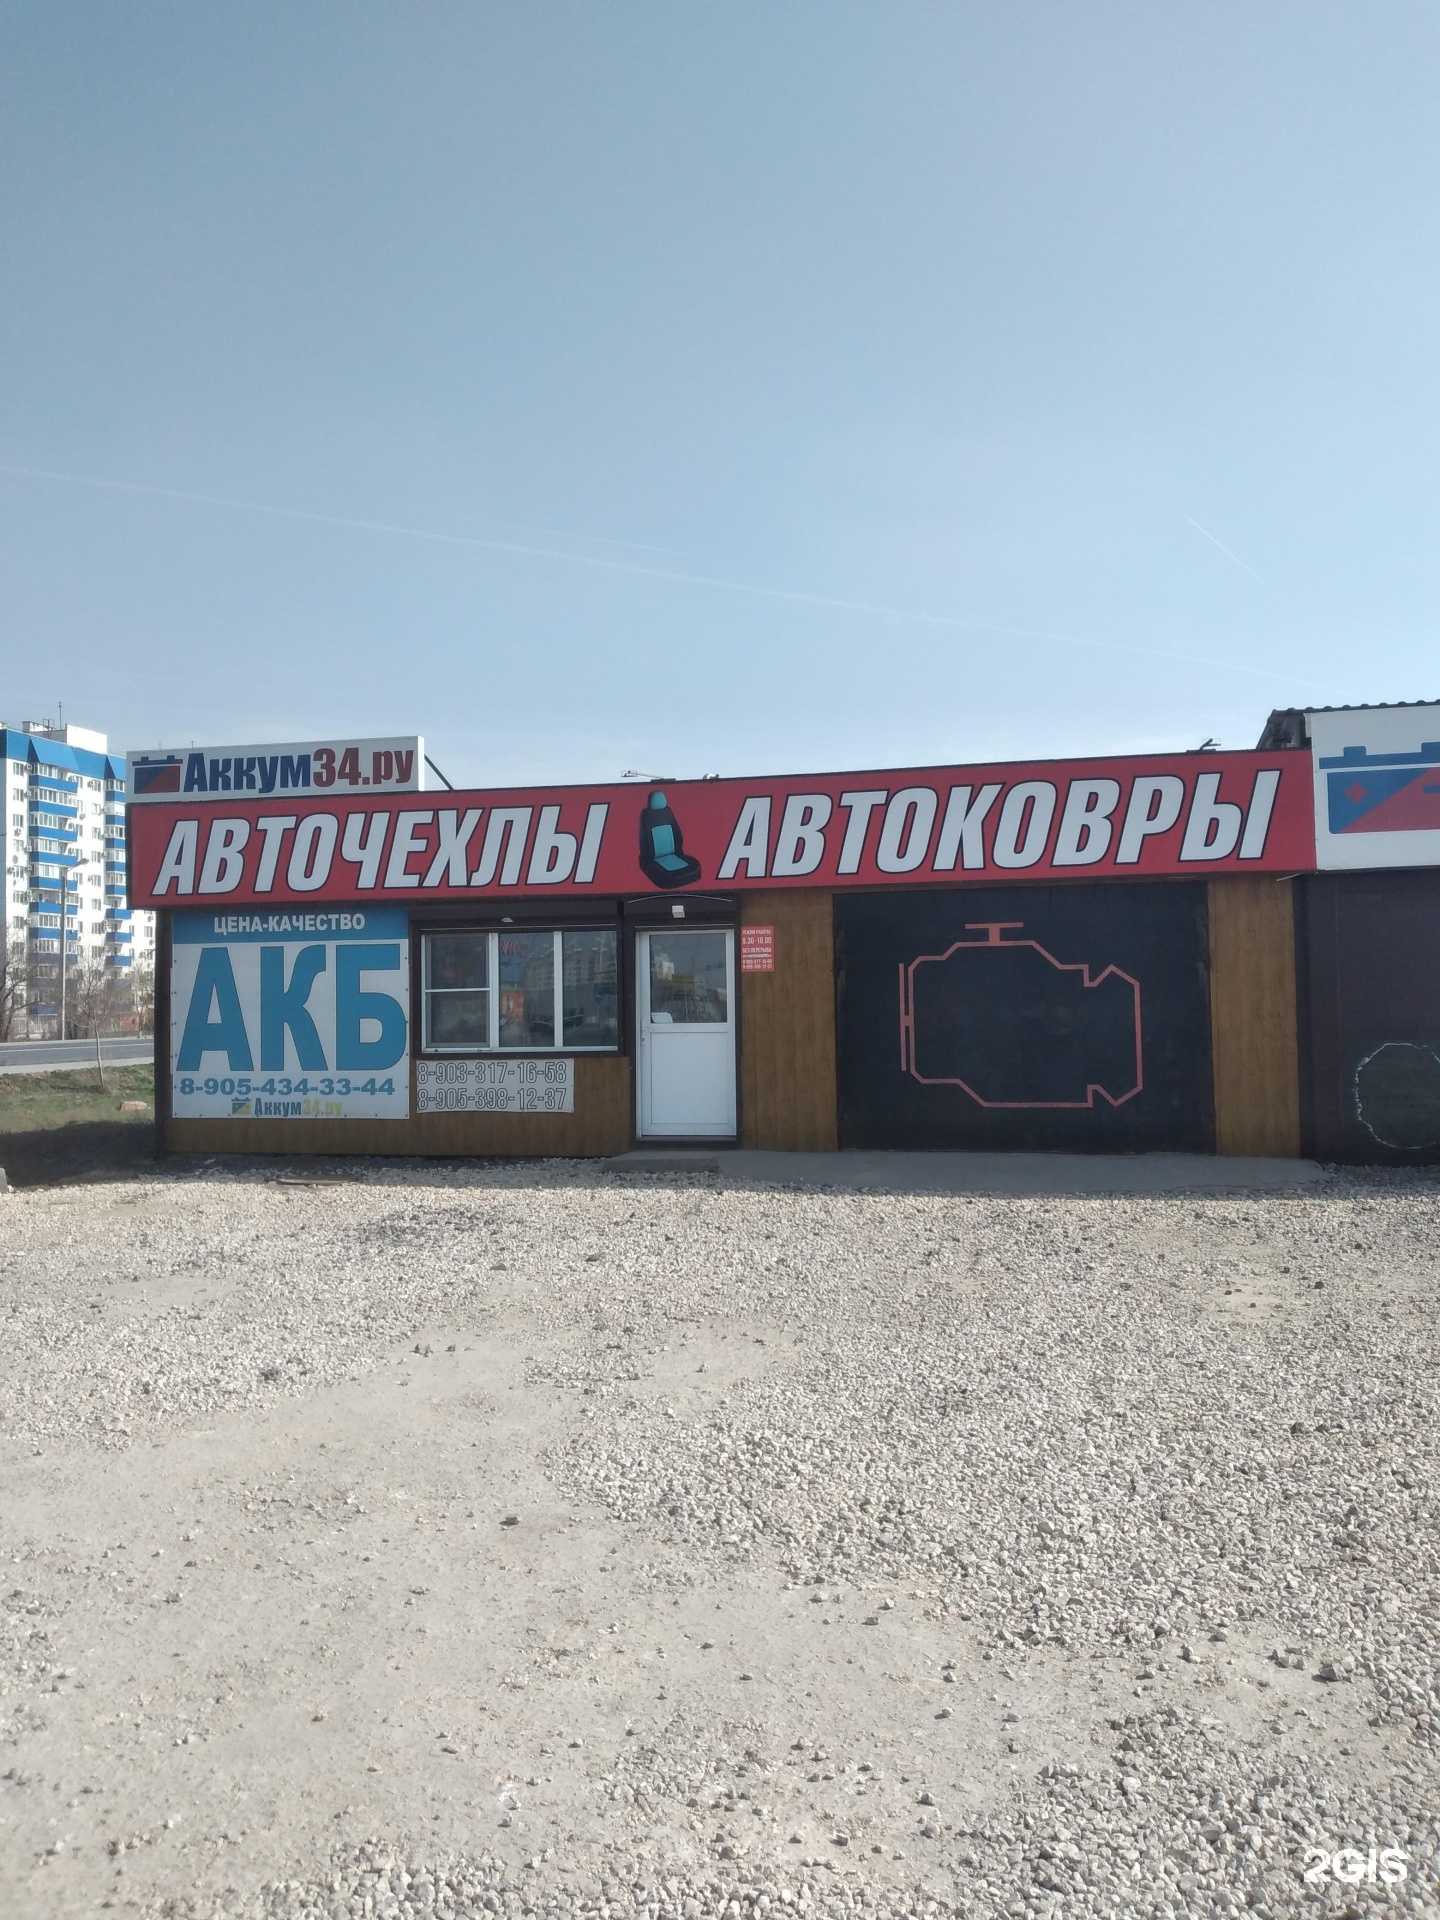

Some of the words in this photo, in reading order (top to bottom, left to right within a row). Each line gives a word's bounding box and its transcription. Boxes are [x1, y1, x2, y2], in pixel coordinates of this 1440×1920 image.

[183, 748, 415, 793] Аккум34.ру
[716, 768, 1281, 880] АВТОКОВРЫ
[151, 802, 610, 897] АВТОЧЕХЛЫ
[213, 913, 366, 936] ЦЕНА-КАЧЕСТВО
[176, 943, 407, 1072] АКБ
[179, 1077, 396, 1096] 8-905-434-33-44
[417, 1061, 567, 1084] 8-903-317-16-58
[417, 1087, 567, 1110] 8-905-398-12-37
